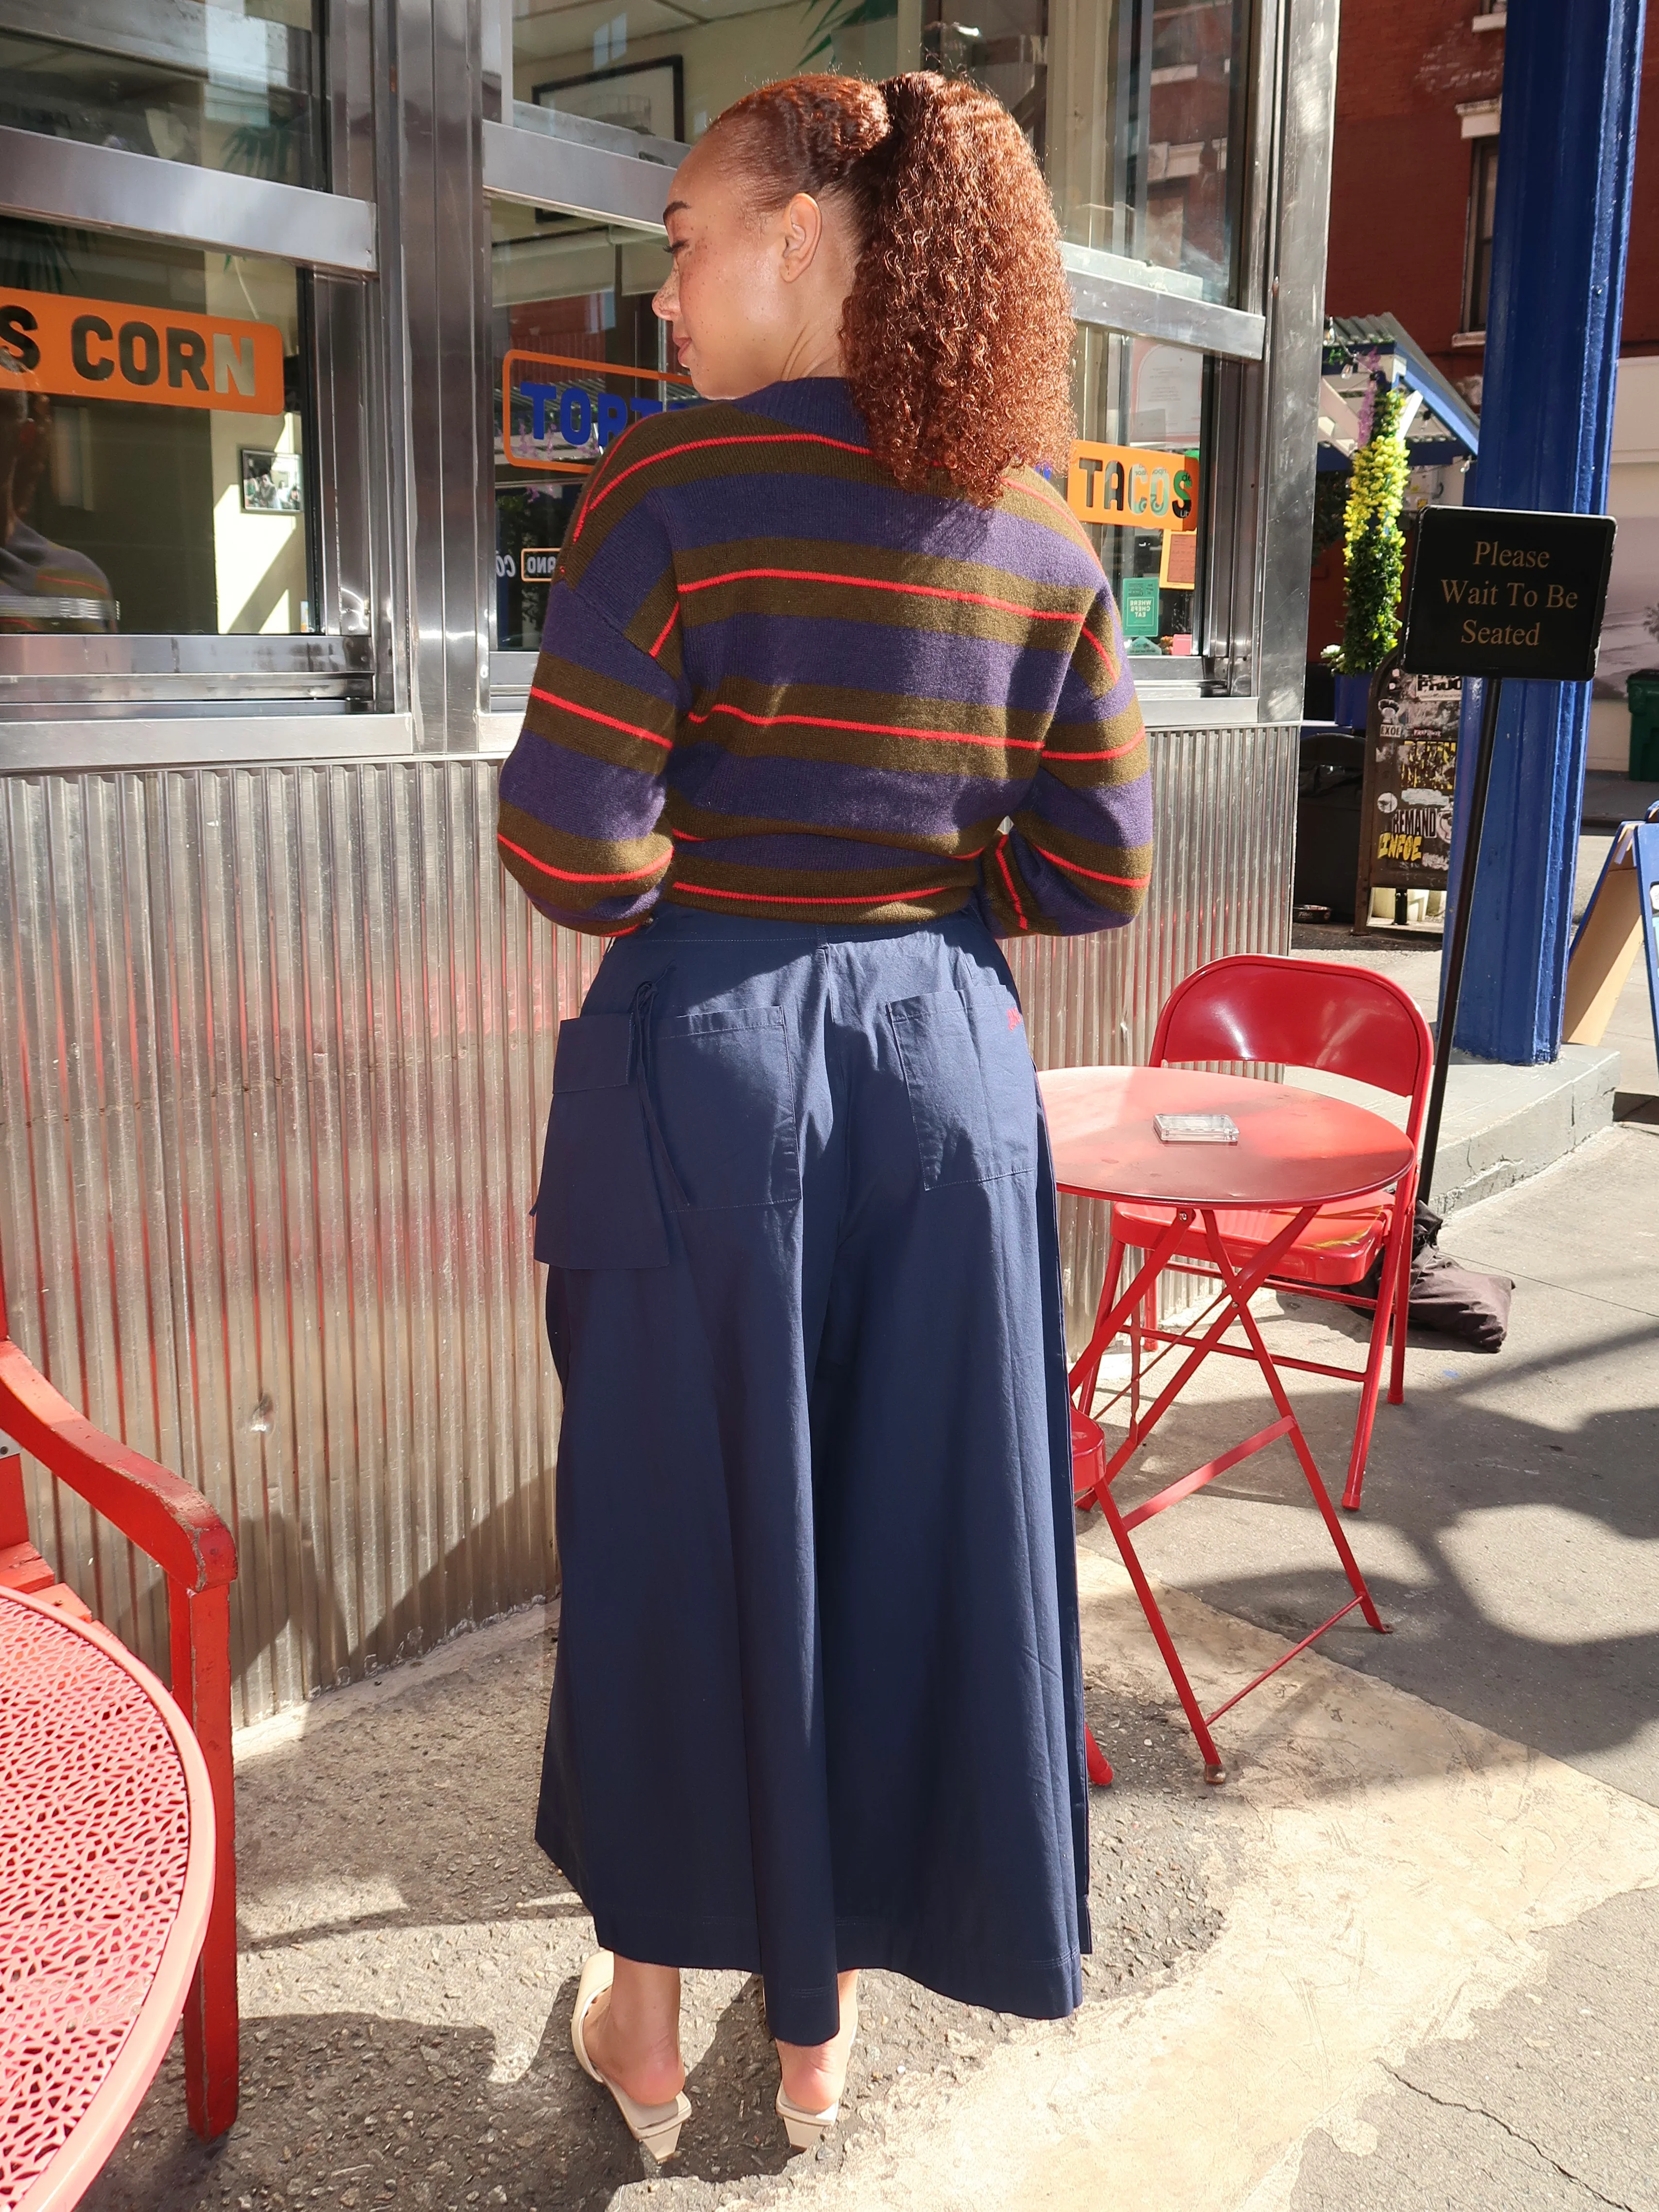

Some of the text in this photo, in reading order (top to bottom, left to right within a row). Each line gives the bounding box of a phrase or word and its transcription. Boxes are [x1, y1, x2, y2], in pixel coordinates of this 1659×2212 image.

[71, 314, 256, 397] CORN
[1078, 457, 1192, 519] TACOS
[1473, 540, 1550, 568] Please
[1441, 579, 1578, 609] Wait To Be
[1461, 619, 1540, 646] Seated
